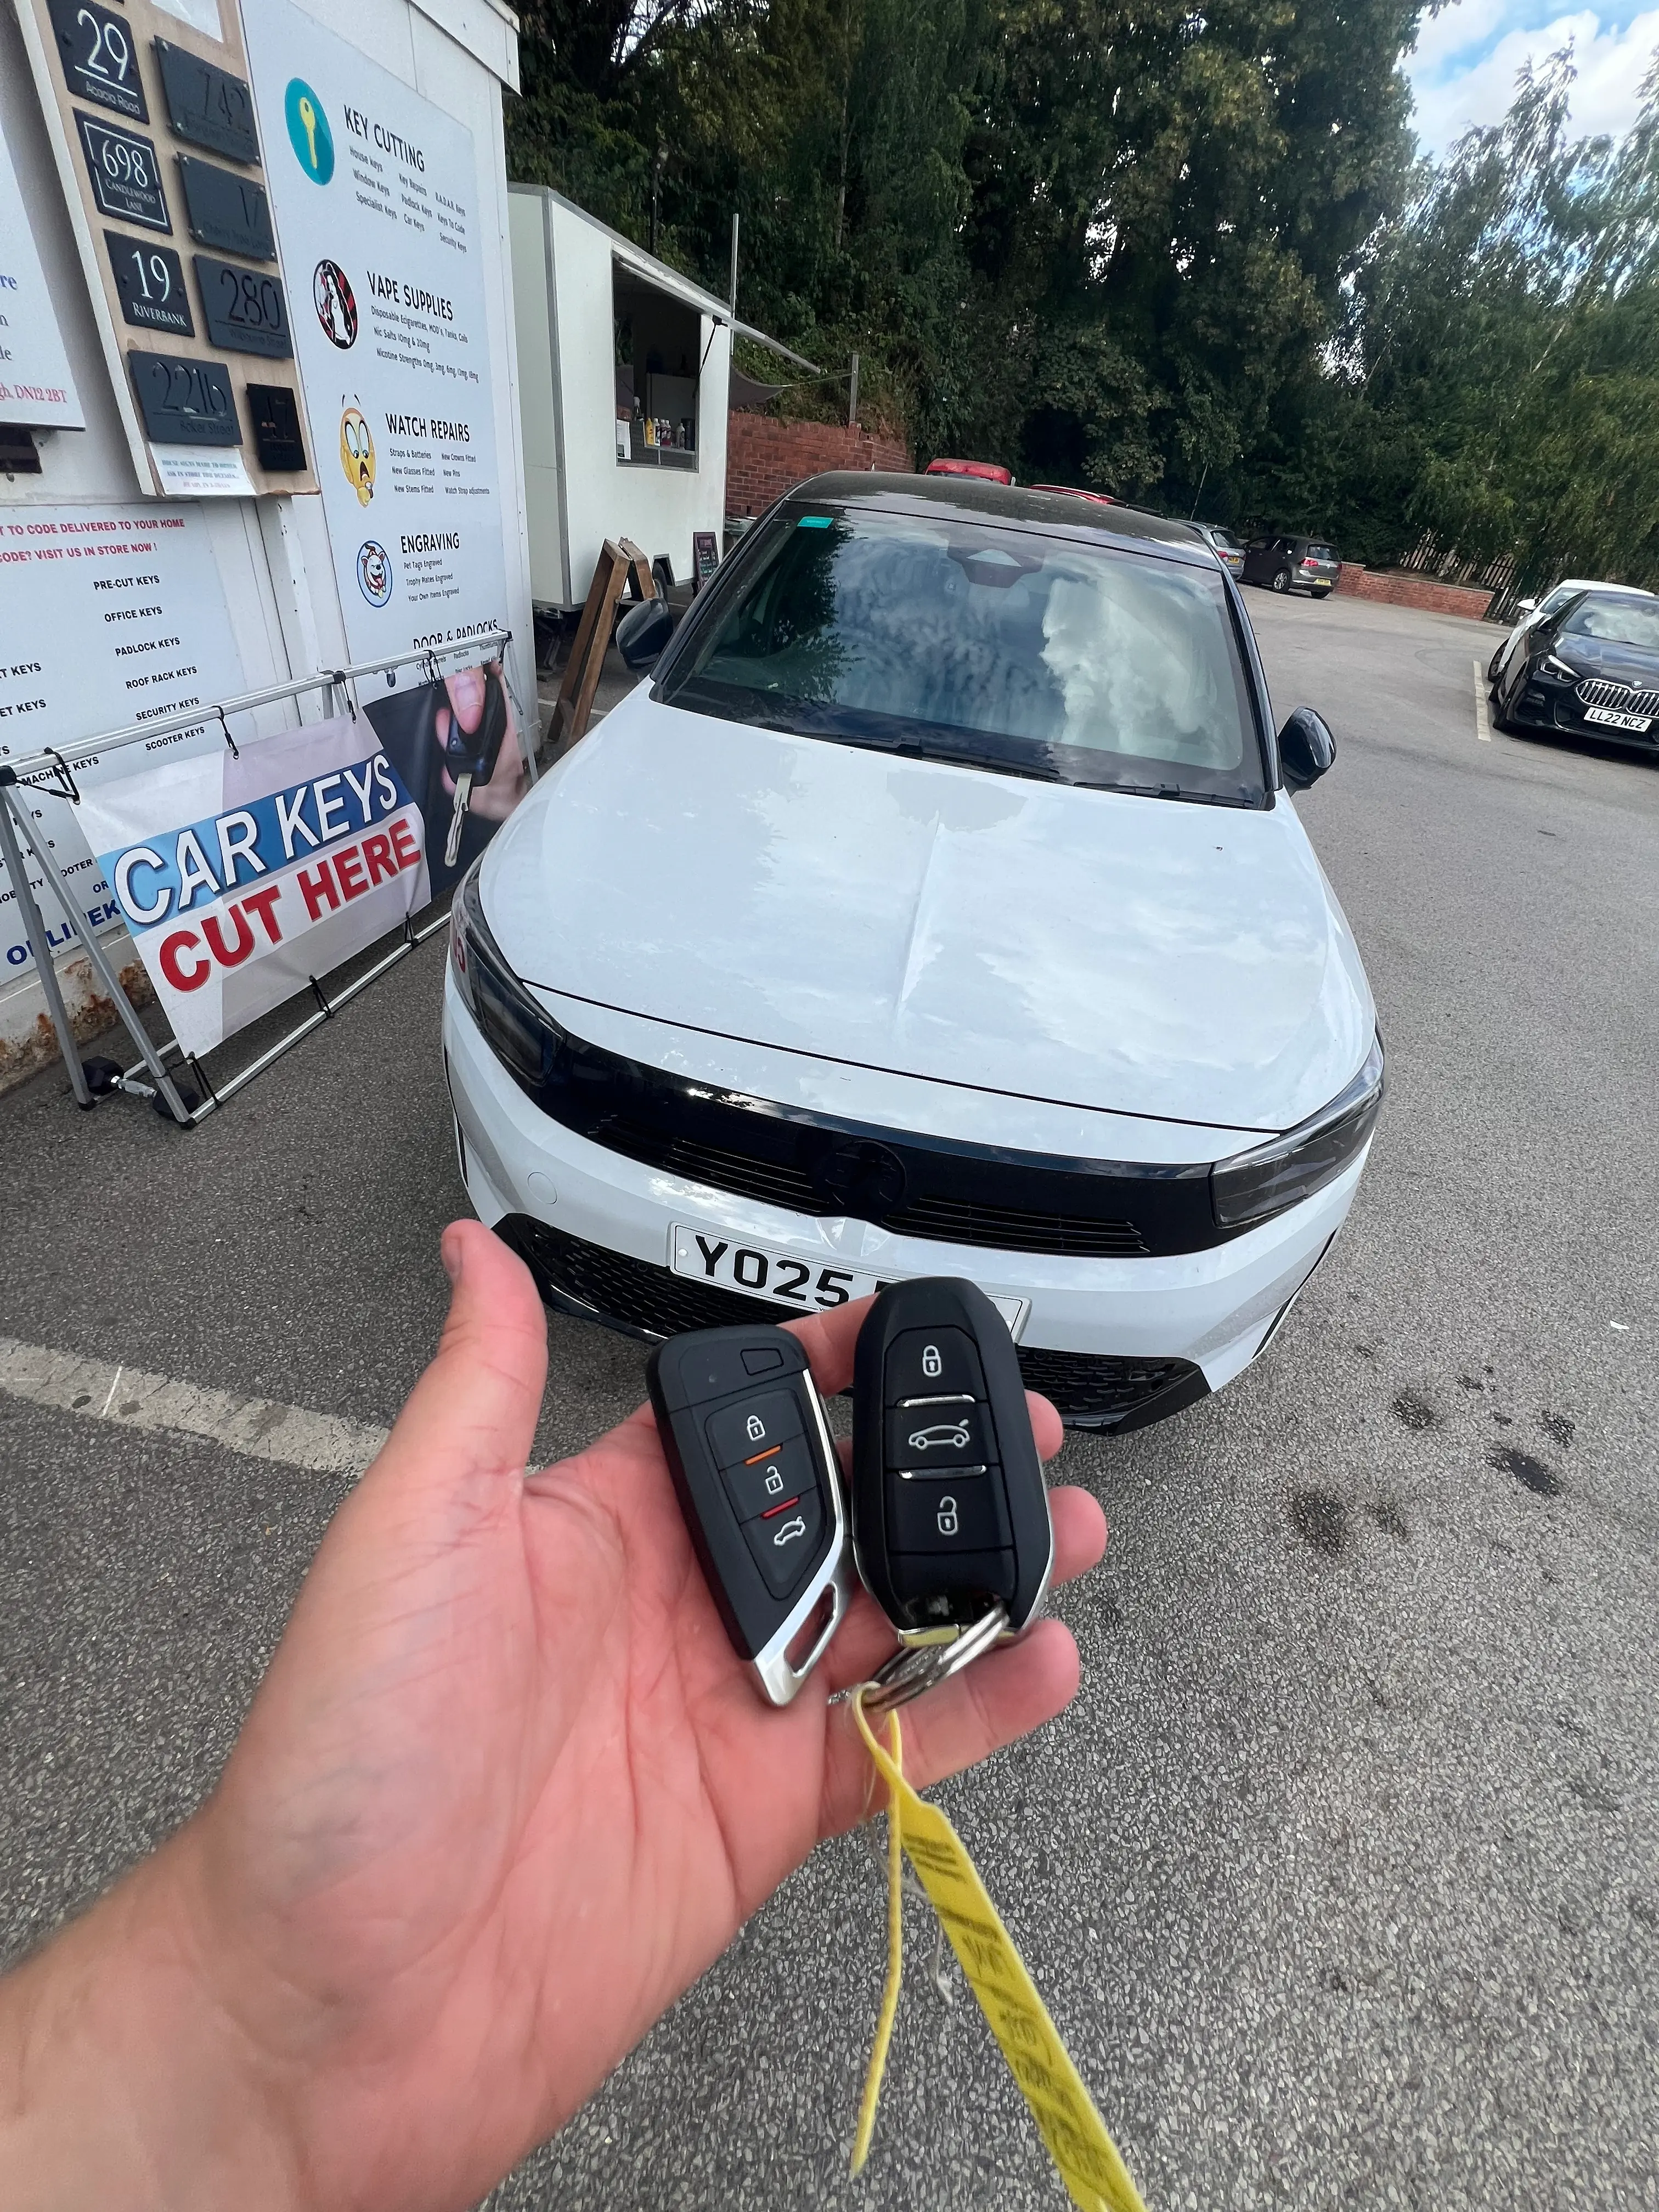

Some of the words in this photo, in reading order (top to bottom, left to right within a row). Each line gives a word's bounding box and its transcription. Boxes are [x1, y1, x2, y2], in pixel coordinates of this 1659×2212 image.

[77, 9, 128, 81] 29
[343, 104, 368, 141] KEY
[374, 123, 425, 173] CUTTING
[103, 140, 148, 187] 698
[349, 145, 369, 165] House
[353, 167, 375, 189] Window
[377, 180, 390, 197] Keys
[356, 191, 383, 213] Specialist
[385, 205, 397, 220] Keys
[132, 251, 170, 302] 19
[221, 269, 280, 330] 280
[366, 270, 400, 303] VAPE
[403, 284, 454, 321] SUPPLIES
[132, 302, 187, 327] RIVERBANK
[371, 306, 399, 323] Disposable
[374, 326, 382, 336] Nic
[383, 329, 397, 341] Salts
[398, 332, 411, 348] 10mg
[412, 337, 416, 346] &
[417, 338, 430, 354] 20mg
[377, 347, 398, 361] Nicotine
[399, 353, 422, 369] Strengths
[13, 385, 44, 400] DN12
[45, 388, 67, 403] 2BT
[153, 362, 227, 416] 221b
[386, 413, 427, 437] WATCH
[431, 419, 470, 442] REPAIRS
[390, 448, 405, 459] Straps
[407, 450, 410, 458] &
[411, 450, 432, 459] Batteries
[441, 453, 450, 461] New
[392, 466, 403, 475] New
[404, 467, 421, 476] Glasses
[422, 467, 435, 476] Fitted
[394, 484, 405, 493] New
[406, 485, 420, 493] Stems
[421, 484, 434, 493] Fitted
[7, 525, 24, 535] TO
[27, 523, 58, 534] CODE
[60, 521, 116, 533] DELIVERED
[118, 521, 132, 531] TO
[133, 520, 159, 529] YOUR
[160, 518, 185, 528] HOME
[34, 549, 63, 560] VISIT
[66, 548, 82, 557] US
[84, 546, 96, 556] IN
[98, 545, 129, 555] STORE
[131, 543, 152, 553] NOW
[400, 532, 460, 554] ENGRAVING
[412, 561, 423, 571] Tags
[424, 557, 443, 570] Engraved
[93, 578, 133, 590] PRE-CUT
[137, 575, 160, 586] KEYS
[406, 578, 421, 586] Trophy
[435, 572, 453, 584] Engraved
[442, 586, 460, 599] Engraved
[104, 610, 138, 622] OFFICE
[139, 606, 163, 618] KEYS
[115, 641, 157, 657] PADLOCK
[158, 637, 180, 648] KEYS
[11, 663, 42, 676] KEYS
[126, 677, 150, 689] ROOF
[151, 671, 175, 684] RACK
[176, 666, 198, 678] KEYS
[16, 699, 47, 713] KEYS
[136, 703, 177, 721] SECURITY
[179, 697, 200, 709] KEYS
[1590, 710, 1621, 724] LL22
[1621, 716, 1646, 729] NCZ
[145, 733, 183, 751] SCOOTER
[184, 726, 205, 739] KEYS
[73, 757, 99, 771] KEYS
[114, 810, 267, 924] CAR
[275, 754, 397, 859] KEYS
[160, 885, 283, 992] CUT
[297, 819, 421, 922] HERE
[695, 1234, 854, 1307] YO25
